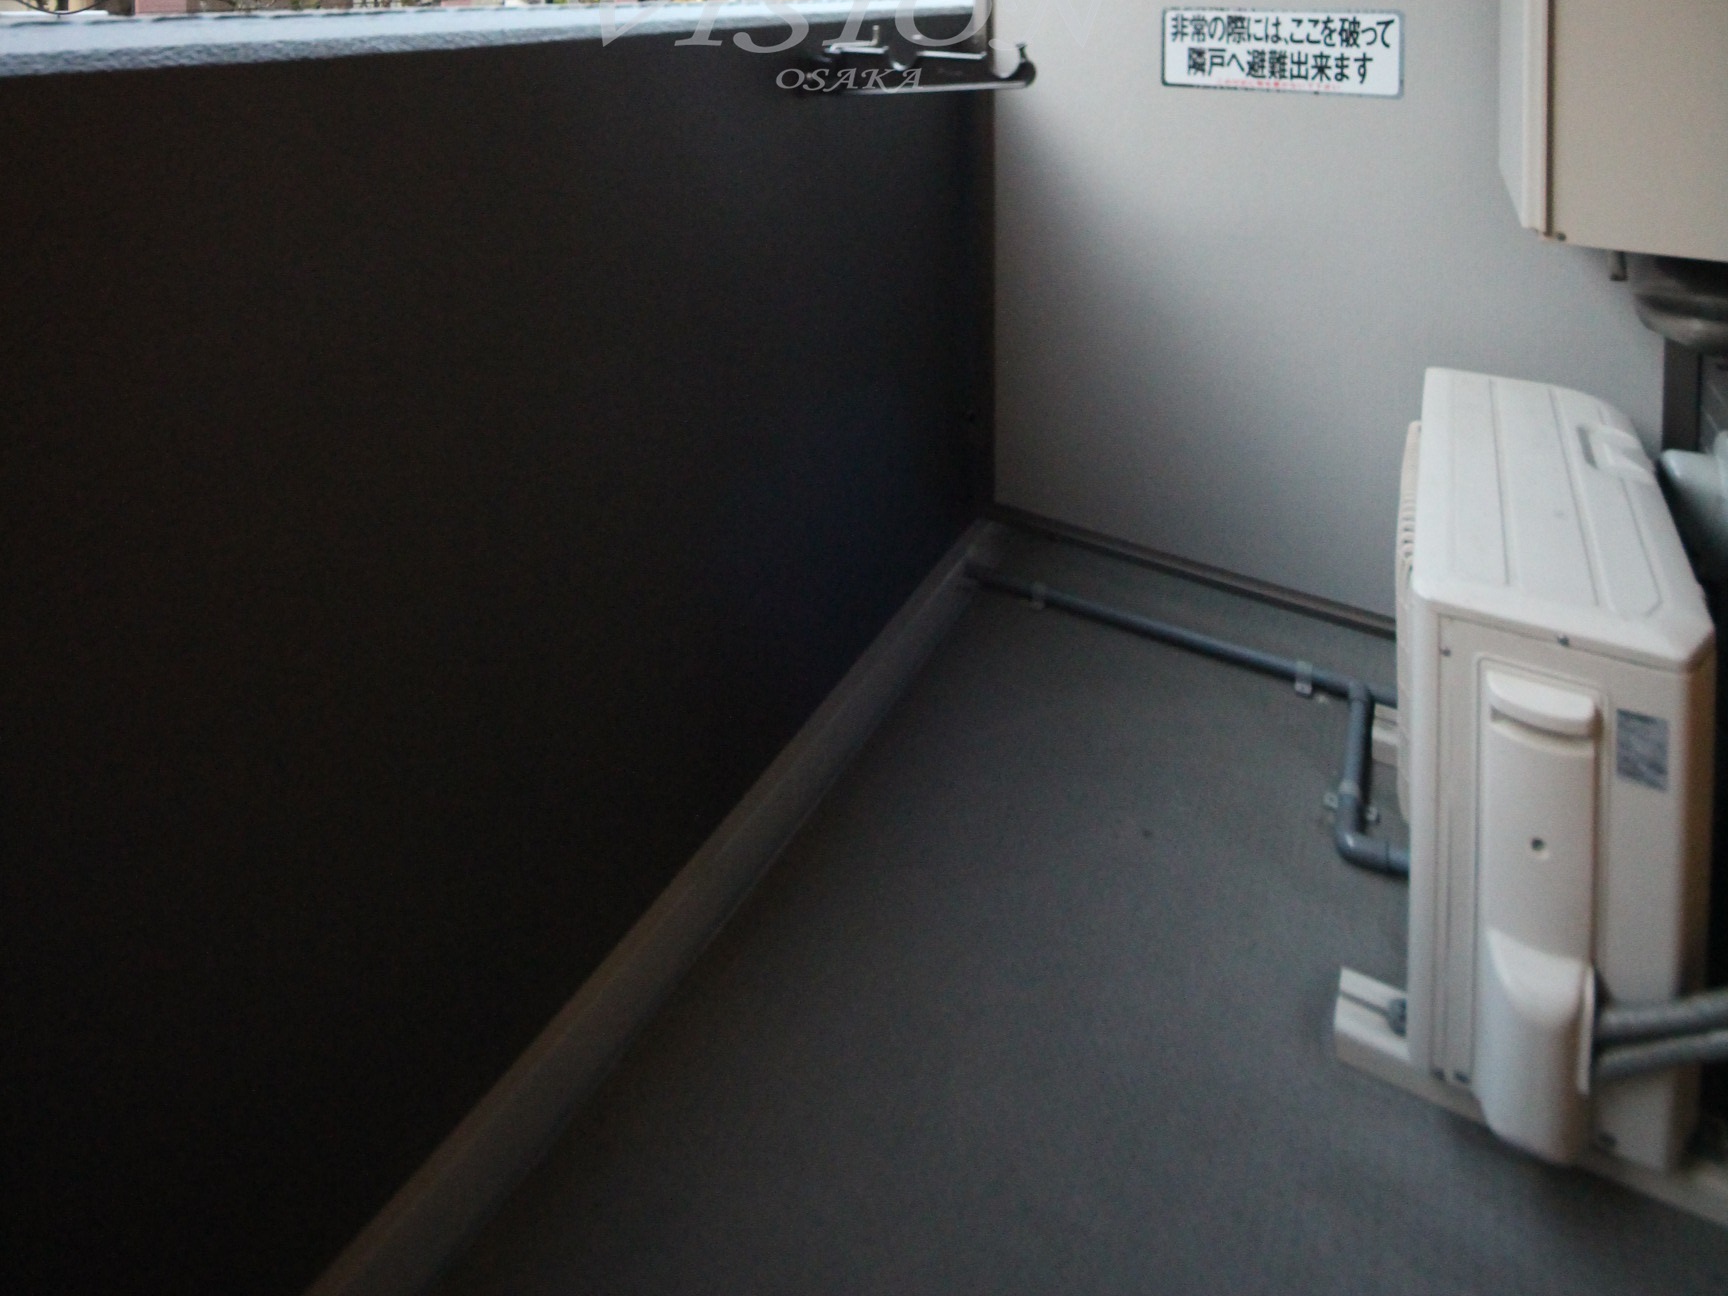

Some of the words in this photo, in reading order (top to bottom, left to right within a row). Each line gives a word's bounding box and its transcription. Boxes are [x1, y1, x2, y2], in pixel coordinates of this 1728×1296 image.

[1170, 13, 1395, 49] 非常の際には、ここを破って
[1187, 47, 1374, 84] 隣戸へ避難出来ます
